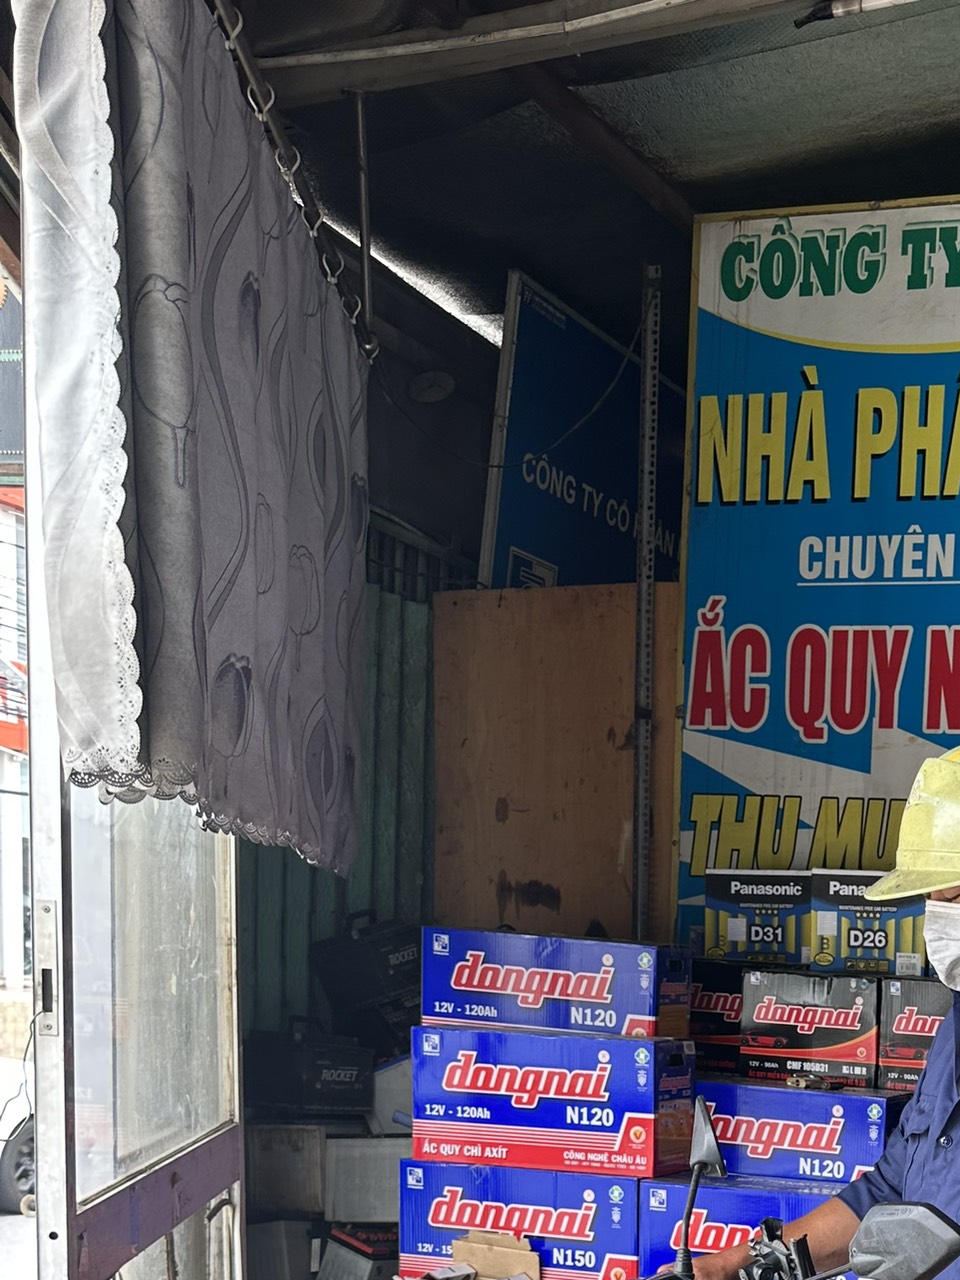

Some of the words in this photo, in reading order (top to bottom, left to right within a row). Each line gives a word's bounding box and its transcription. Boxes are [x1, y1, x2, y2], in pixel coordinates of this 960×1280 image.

[720, 215, 887, 302] CÔNG
[696, 365, 832, 504] NHÀ
[522, 452, 576, 504] CÔNG
[582, 482, 603, 519] TY
[799, 524, 955, 580] CHUYÊN
[687, 595, 770, 732] ẮC
[785, 624, 913, 742] QUY
[689, 793, 802, 876] THU
[807, 796, 910, 870] MU
[730, 880, 802, 897] Panasonic
[751, 925, 783, 943] D31
[850, 930, 887, 948] D26
[388, 947, 418, 966] ROCKET
[434, 1001, 454, 1013] 12V
[464, 1004, 497, 1018] 120Ah
[570, 1007, 616, 1028] N120
[787, 1061, 802, 1070] CMF
[321, 1069, 359, 1083] ROCKET
[424, 1104, 445, 1116] 12V
[456, 1106, 491, 1120] 120Ah
[566, 1106, 614, 1127] N120
[440, 1143, 461, 1157] QUY
[463, 1143, 482, 1157] CHÌ
[484, 1145, 508, 1159] AXÍT
[563, 1149, 586, 1160] CÔNG
[587, 1152, 609, 1162] NGHỆ
[611, 1154, 633, 1164] CHÂU
[635, 1154, 647, 1165] ÂU
[799, 1157, 845, 1178] N120
[417, 1243, 434, 1253] 12V
[552, 1248, 596, 1268] N150
